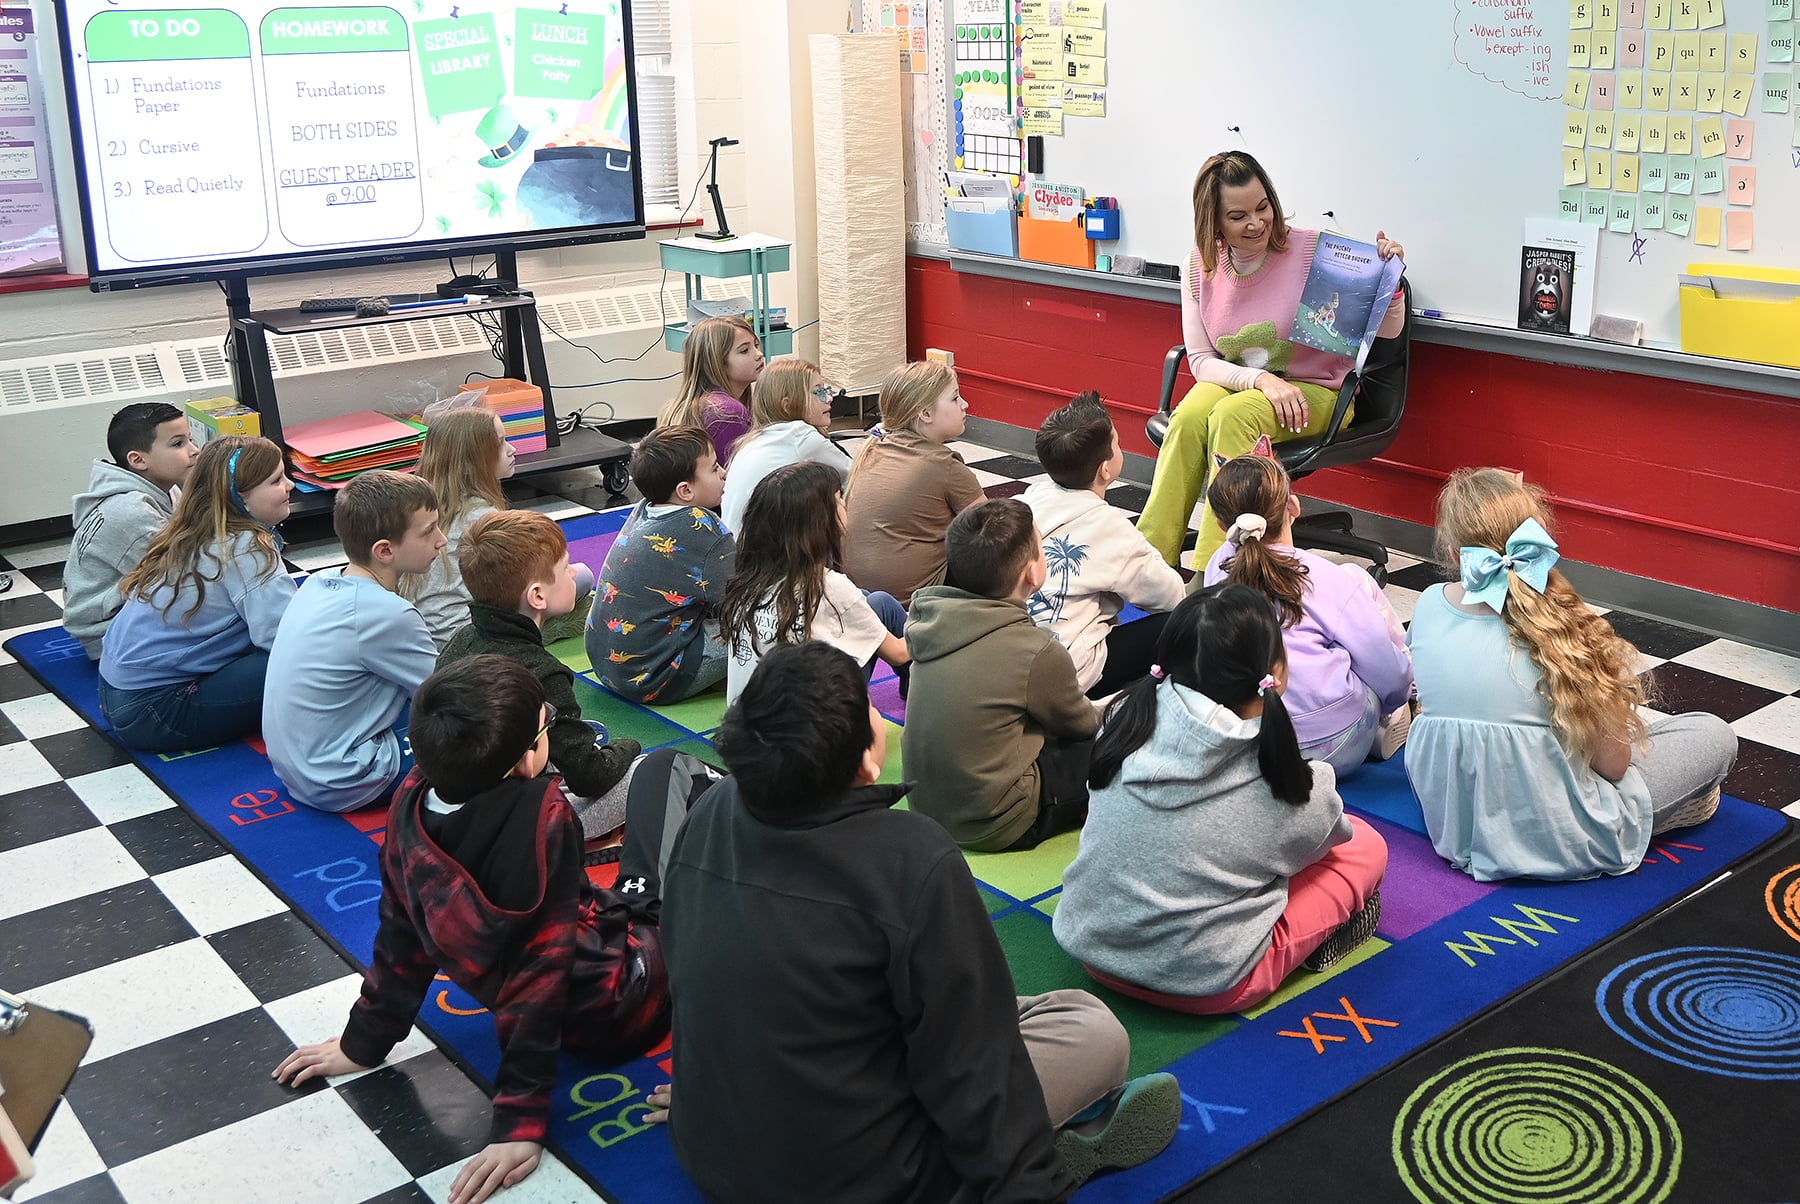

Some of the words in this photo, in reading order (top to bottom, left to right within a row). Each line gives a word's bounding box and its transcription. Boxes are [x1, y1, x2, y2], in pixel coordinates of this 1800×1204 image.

[1503, 7, 1533, 21] suffix
[1577, 4, 1585, 18] g
[1602, 5, 1610, 16] h
[1630, 2, 1635, 14] i
[1654, 3, 1661, 18] j
[1681, 2, 1690, 15] k
[128, 19, 160, 38] TO
[166, 18, 201, 37] DO
[272, 19, 391, 38] HOMEWORK
[531, 23, 588, 43] LUNCH
[1474, 24, 1505, 38] Vowel
[1510, 24, 1542, 38] suffix
[16, 32, 23, 41] 3
[424, 26, 490, 51] SPECIAL
[1493, 42, 1524, 57] except
[1573, 44, 1585, 53] m
[1600, 45, 1608, 54] n
[1628, 43, 1636, 52] o
[1770, 38, 1792, 50] ong
[1656, 47, 1666, 59] p
[1680, 50, 1694, 60] qu
[1709, 47, 1716, 57] r
[1739, 49, 1747, 59] s
[430, 53, 491, 75] LIBRARY
[532, 53, 581, 68] Chicken
[543, 69, 571, 84] Patty
[104, 78, 120, 95] 1.)
[132, 77, 222, 95] Fundations
[295, 80, 385, 98] Fundations
[1574, 82, 1579, 94] t
[1599, 87, 1607, 96] u
[1626, 85, 1634, 94] v
[1652, 87, 1664, 96] w
[1681, 87, 1689, 96] x
[1707, 88, 1716, 101] y
[1733, 89, 1741, 99] z
[1766, 88, 1788, 100] ung
[134, 98, 180, 116] Paper
[290, 123, 341, 142] BOTH
[346, 120, 398, 139] SIDES
[1569, 124, 1582, 134] wh
[1595, 124, 1607, 134] ch
[1622, 128, 1634, 138] sh
[1649, 129, 1659, 138] th
[1674, 130, 1686, 140] ck
[1703, 132, 1720, 144] tch
[1735, 134, 1744, 147] y
[108, 141, 127, 157] 2.)
[138, 139, 200, 155] Cursive
[280, 167, 339, 187] GUEST
[344, 162, 416, 182] READER
[1623, 169, 1631, 178] s
[1649, 169, 1661, 178] all
[1674, 172, 1690, 180] am
[1704, 170, 1717, 179] an
[113, 181, 132, 198] 3.)
[144, 179, 184, 196] Read
[186, 174, 244, 194] Quietly
[325, 191, 338, 205] @
[340, 185, 376, 203] 9:00
[1034, 189, 1073, 207] Clydeo
[1526, 250, 1549, 258] JASPER
